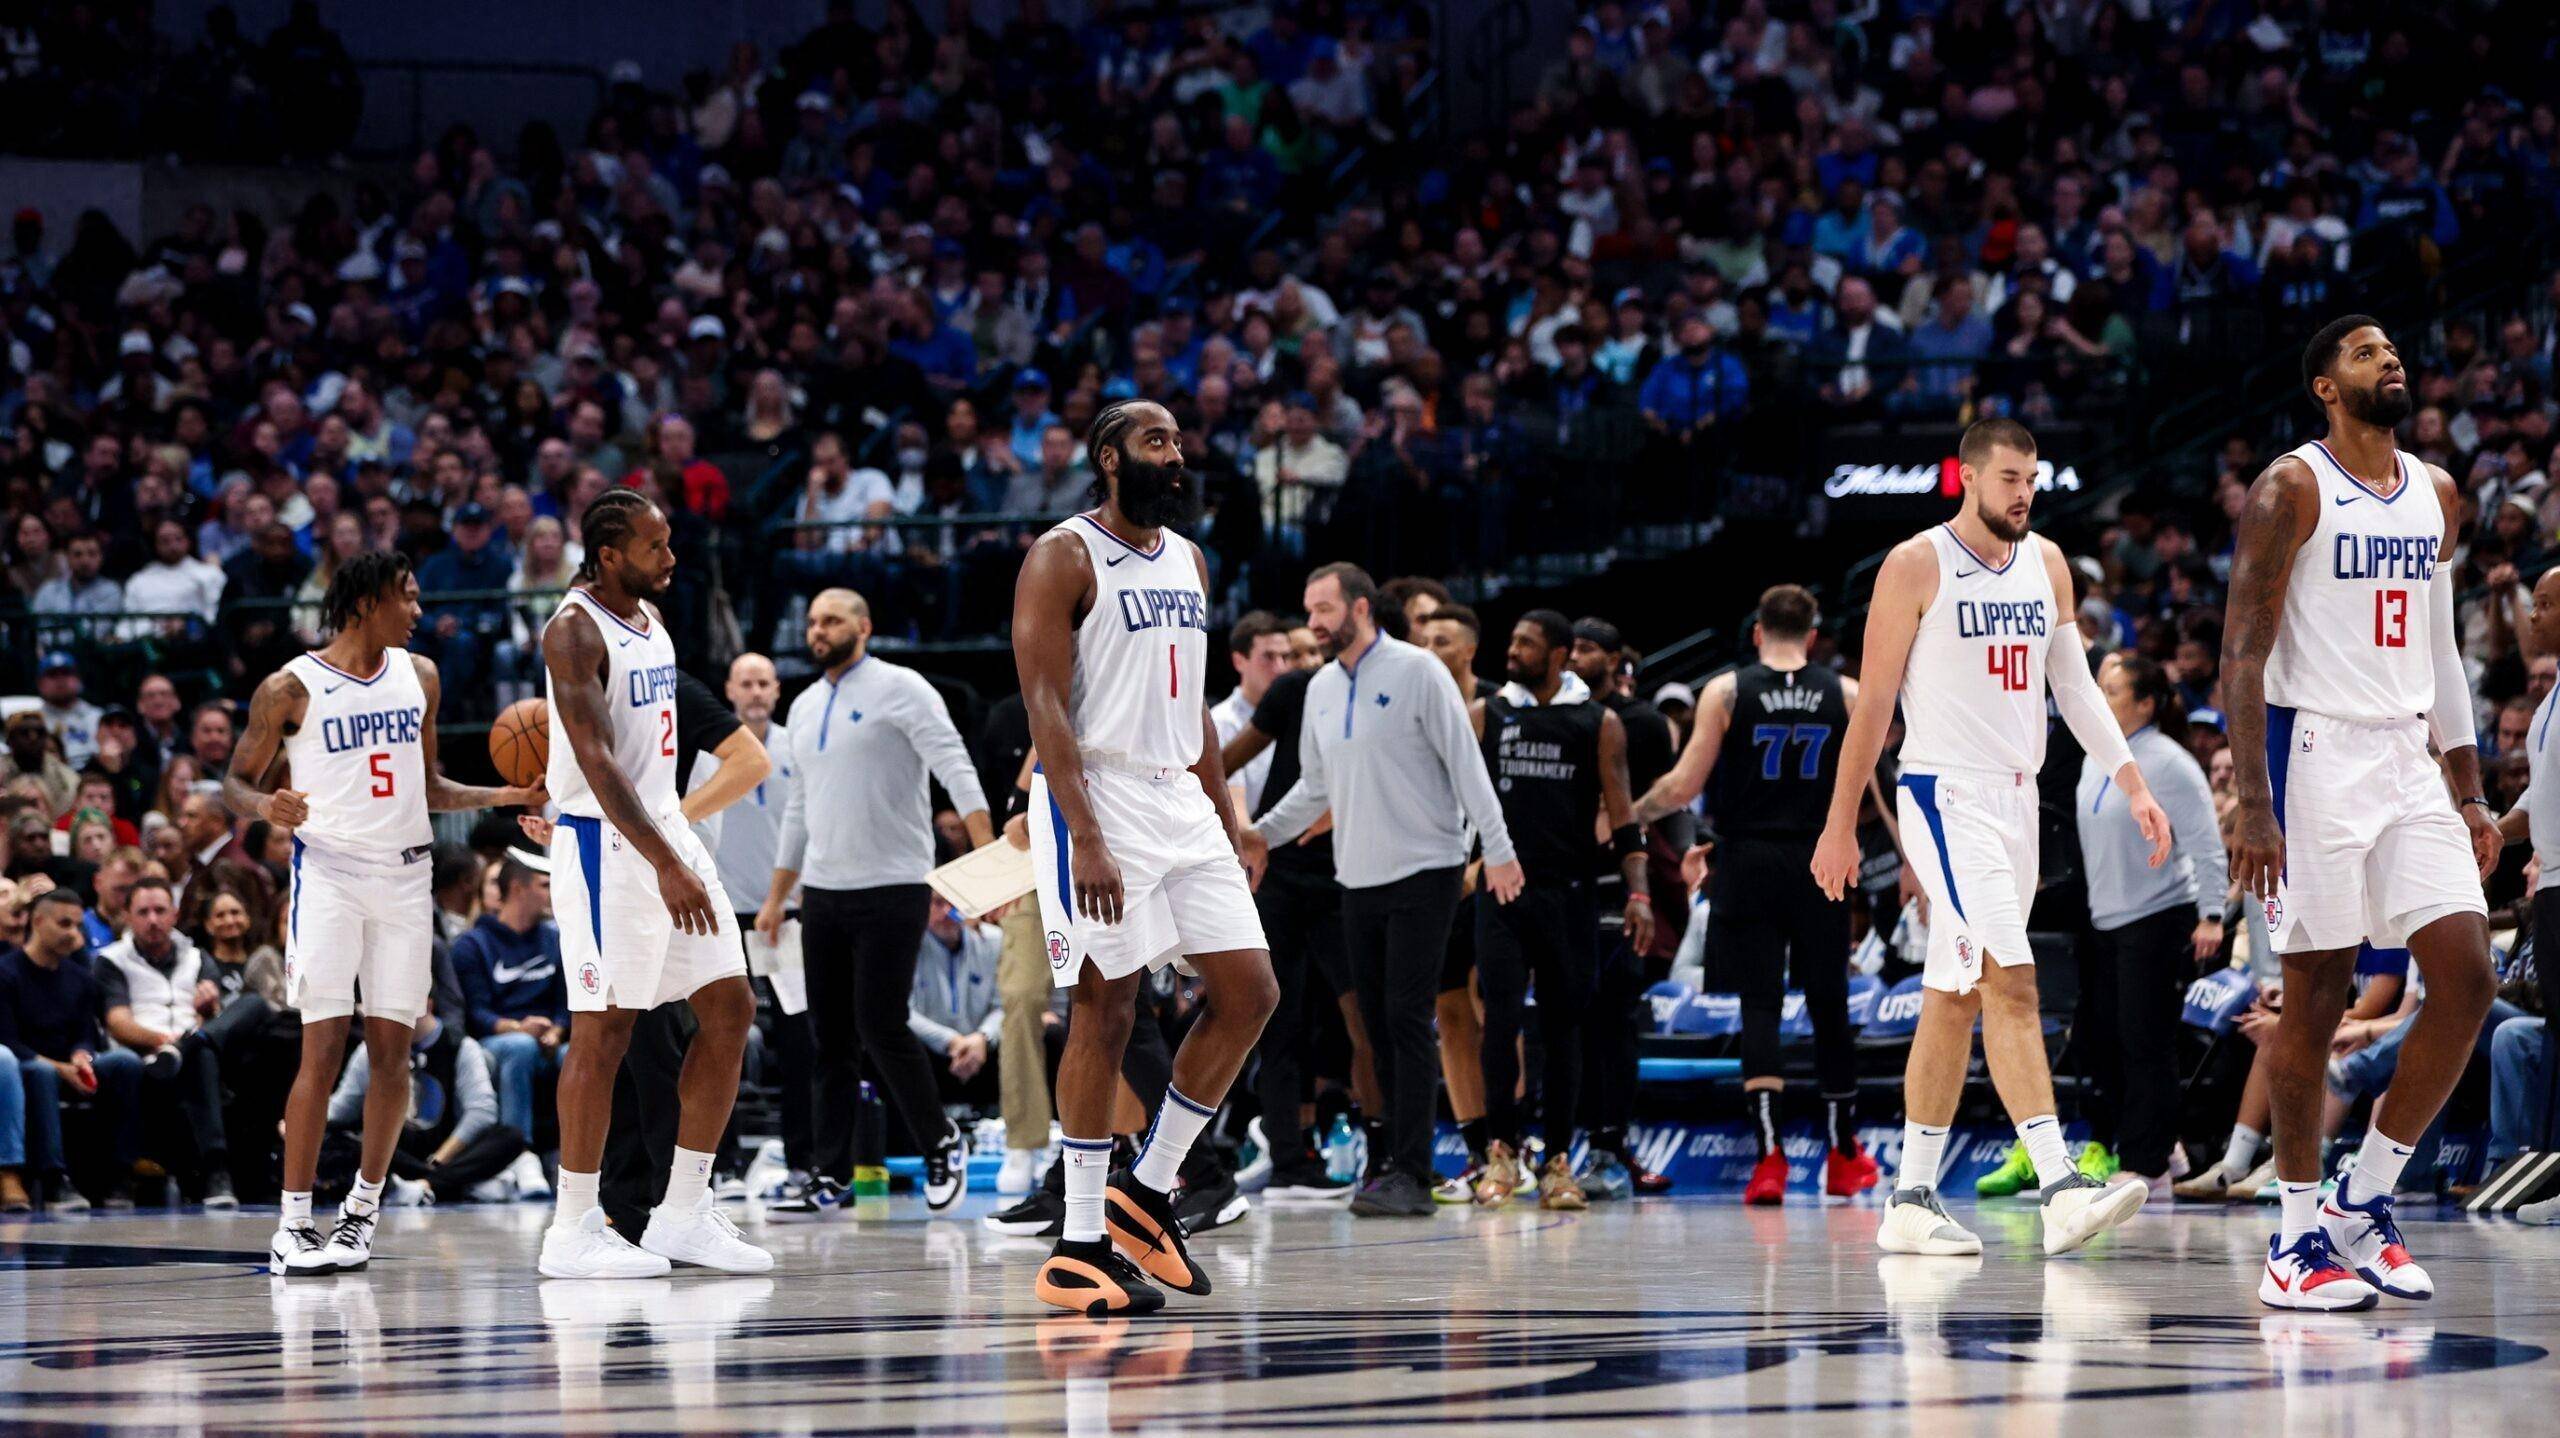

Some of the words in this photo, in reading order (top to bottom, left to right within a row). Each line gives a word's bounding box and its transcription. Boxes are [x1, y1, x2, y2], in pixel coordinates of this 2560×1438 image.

[2333, 533, 2438, 581] CLIPPERS
[1117, 588, 1208, 634] CLIPPERS
[1957, 600, 2045, 638] CLIPPERS
[2375, 590, 2407, 647] 13
[1169, 644, 1177, 698] 1
[1988, 645, 2028, 691] 40
[322, 707, 421, 753] CLIPPERS
[661, 710, 675, 757] 2
[1752, 723, 1832, 780] 77
[370, 753, 394, 798] 5
